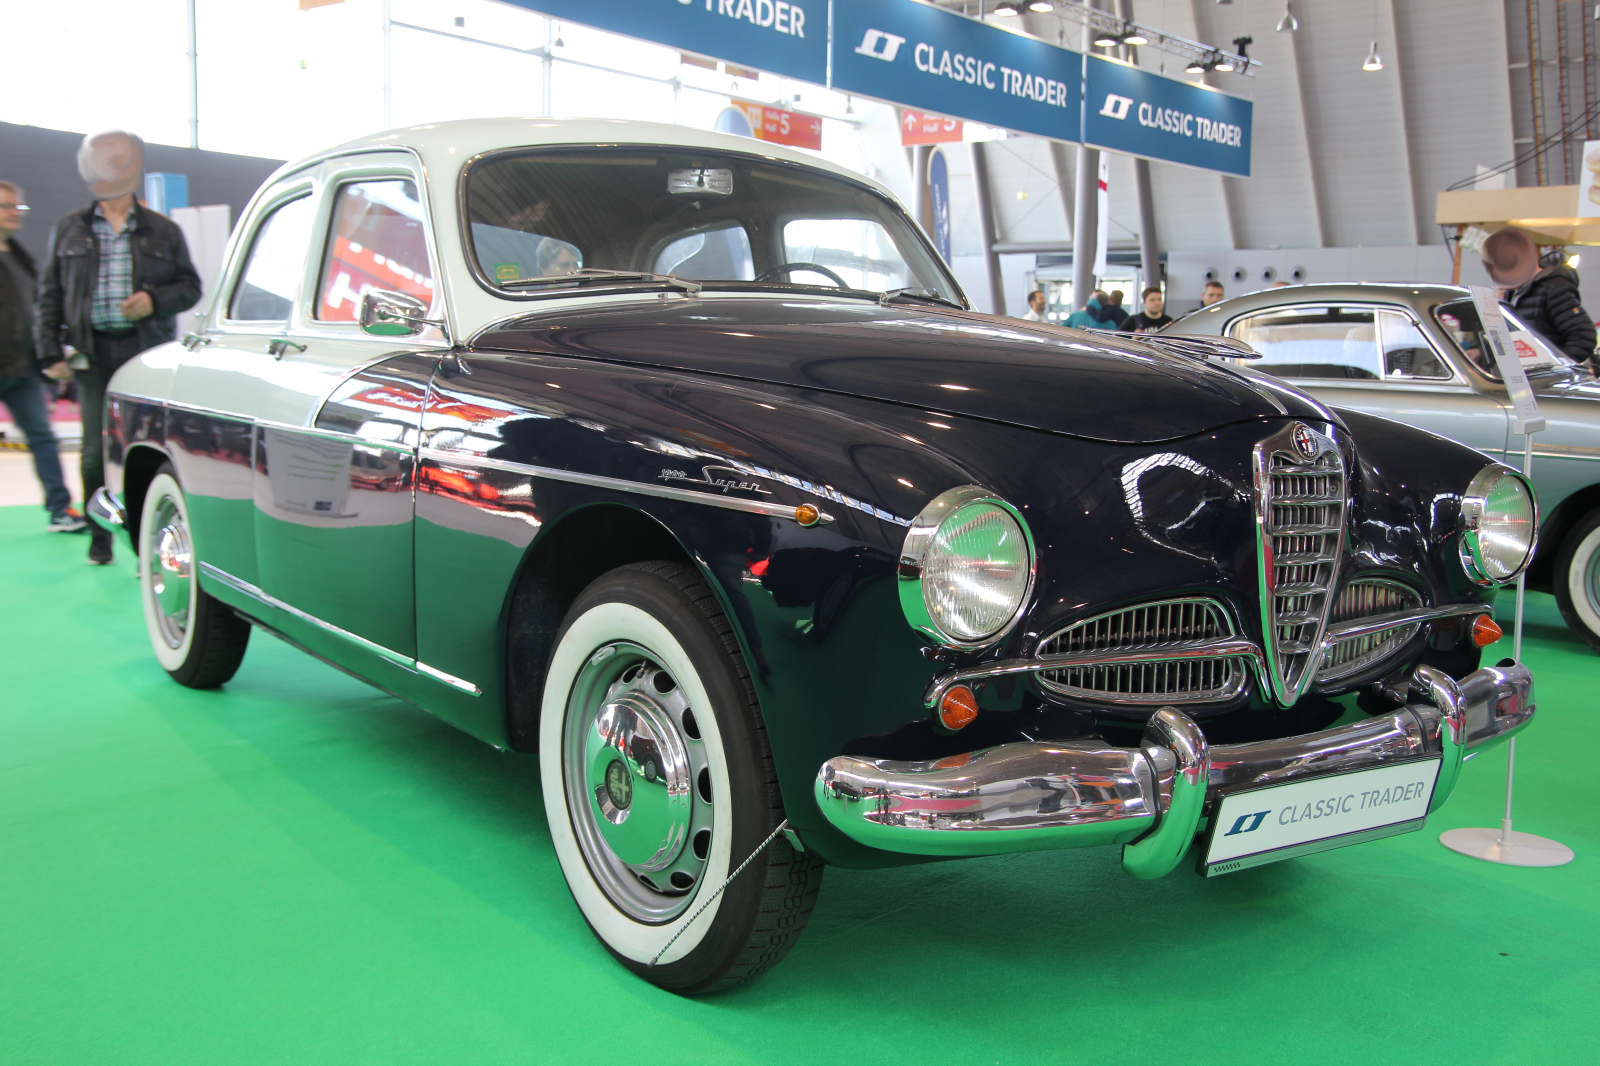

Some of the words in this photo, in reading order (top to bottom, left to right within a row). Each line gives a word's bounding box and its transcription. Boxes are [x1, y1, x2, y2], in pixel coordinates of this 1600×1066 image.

[914, 42, 996, 90] CLASSIC
[1000, 66, 1068, 108] TRADER
[780, 113, 791, 136] 5
[922, 123, 939, 134] Hall
[1138, 102, 1194, 138] CLASSIC
[1196, 116, 1242, 148] TRADER
[701, 465, 773, 494] Super
[1278, 794, 1355, 826] CLASSIC
[1360, 781, 1425, 810] TRADER
